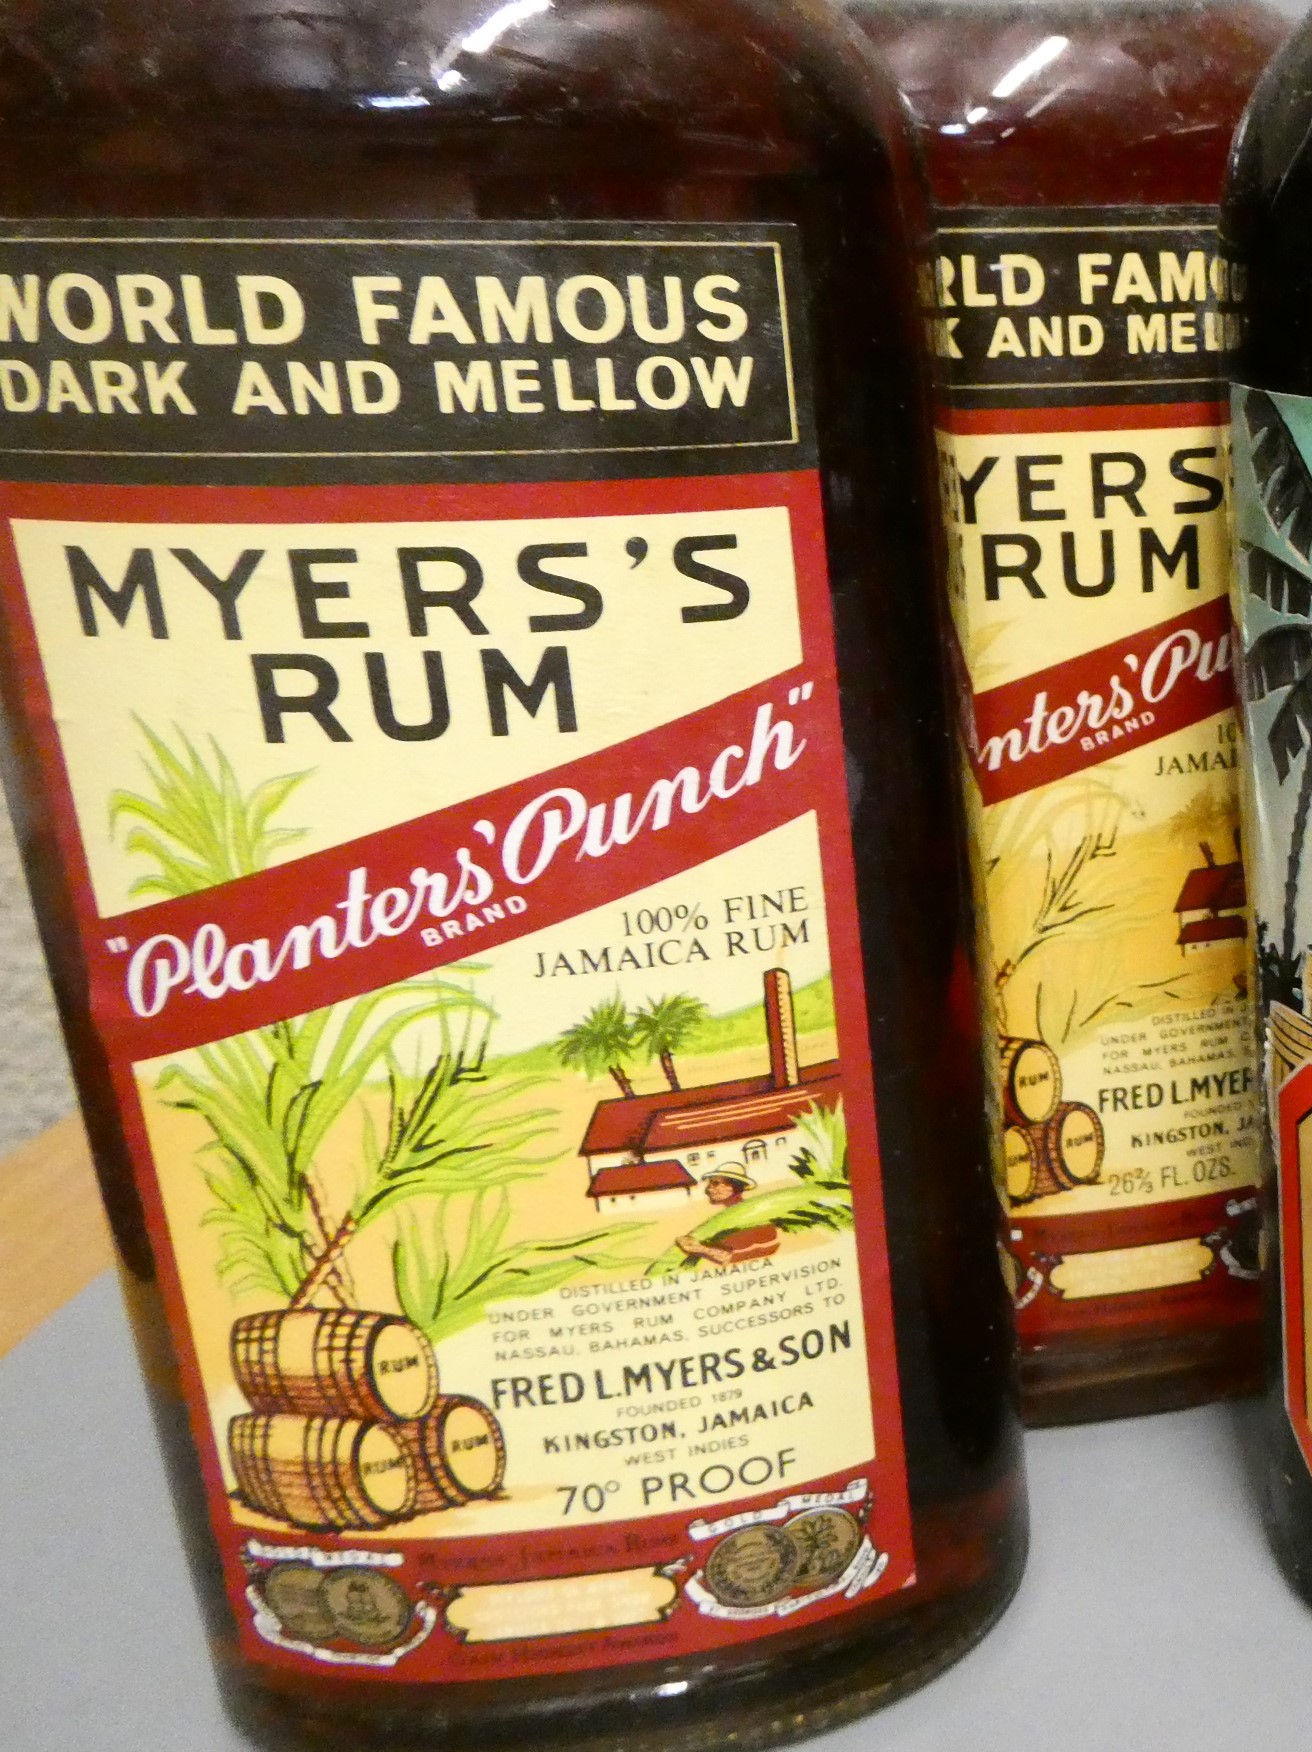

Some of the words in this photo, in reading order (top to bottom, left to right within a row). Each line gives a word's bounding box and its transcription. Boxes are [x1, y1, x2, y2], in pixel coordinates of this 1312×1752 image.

[352, 274, 749, 345] FAMOUS
[986, 314, 1104, 358] AND
[0, 360, 198, 415] DARK
[232, 360, 400, 416] AND
[434, 356, 754, 414] MELLOW
[980, 524, 1200, 601] RUM
[63, 533, 751, 641] MYERS'S
[251, 646, 577, 744] RUM
[1080, 710, 1155, 751] BRAND
[421, 895, 528, 948] BRAND
[621, 901, 708, 938] 100%
[724, 886, 808, 920] FINE
[534, 932, 711, 979] JAMAICA
[726, 918, 810, 953] RUM
[1100, 1032, 1147, 1046] UNDER
[1102, 1049, 1128, 1060] FOR
[1098, 1082, 1164, 1113] FRED
[1160, 1165, 1188, 1187] FL.
[1192, 1155, 1236, 1183] OZS.
[488, 1307, 554, 1325] UNDER
[571, 1288, 702, 1317] GOVERNMENT
[720, 1257, 842, 1297] SUPERVISION
[559, 1278, 653, 1300] DISTILLED
[662, 1273, 679, 1287] IN
[689, 1257, 774, 1283] JAMAICA
[492, 1329, 530, 1344] FOR
[549, 1321, 614, 1339] MYERS
[633, 1314, 674, 1329] RUM
[693, 1291, 787, 1321] COMPANY
[805, 1278, 843, 1297] LTD.
[698, 1304, 814, 1339] SUCCESSORS
[823, 1292, 846, 1309] TO
[379, 1354, 419, 1376] RUM
[490, 1371, 585, 1411] FRED
[616, 1395, 702, 1419] FOUNDED
[711, 1388, 744, 1404] 1879
[451, 1433, 489, 1453] RUM
[542, 1420, 686, 1454] KINGSTON,
[698, 1391, 814, 1434] JAMAICA
[624, 1448, 677, 1466] WEST
[688, 1434, 750, 1457] INDIES
[641, 1447, 796, 1506] PROOF
